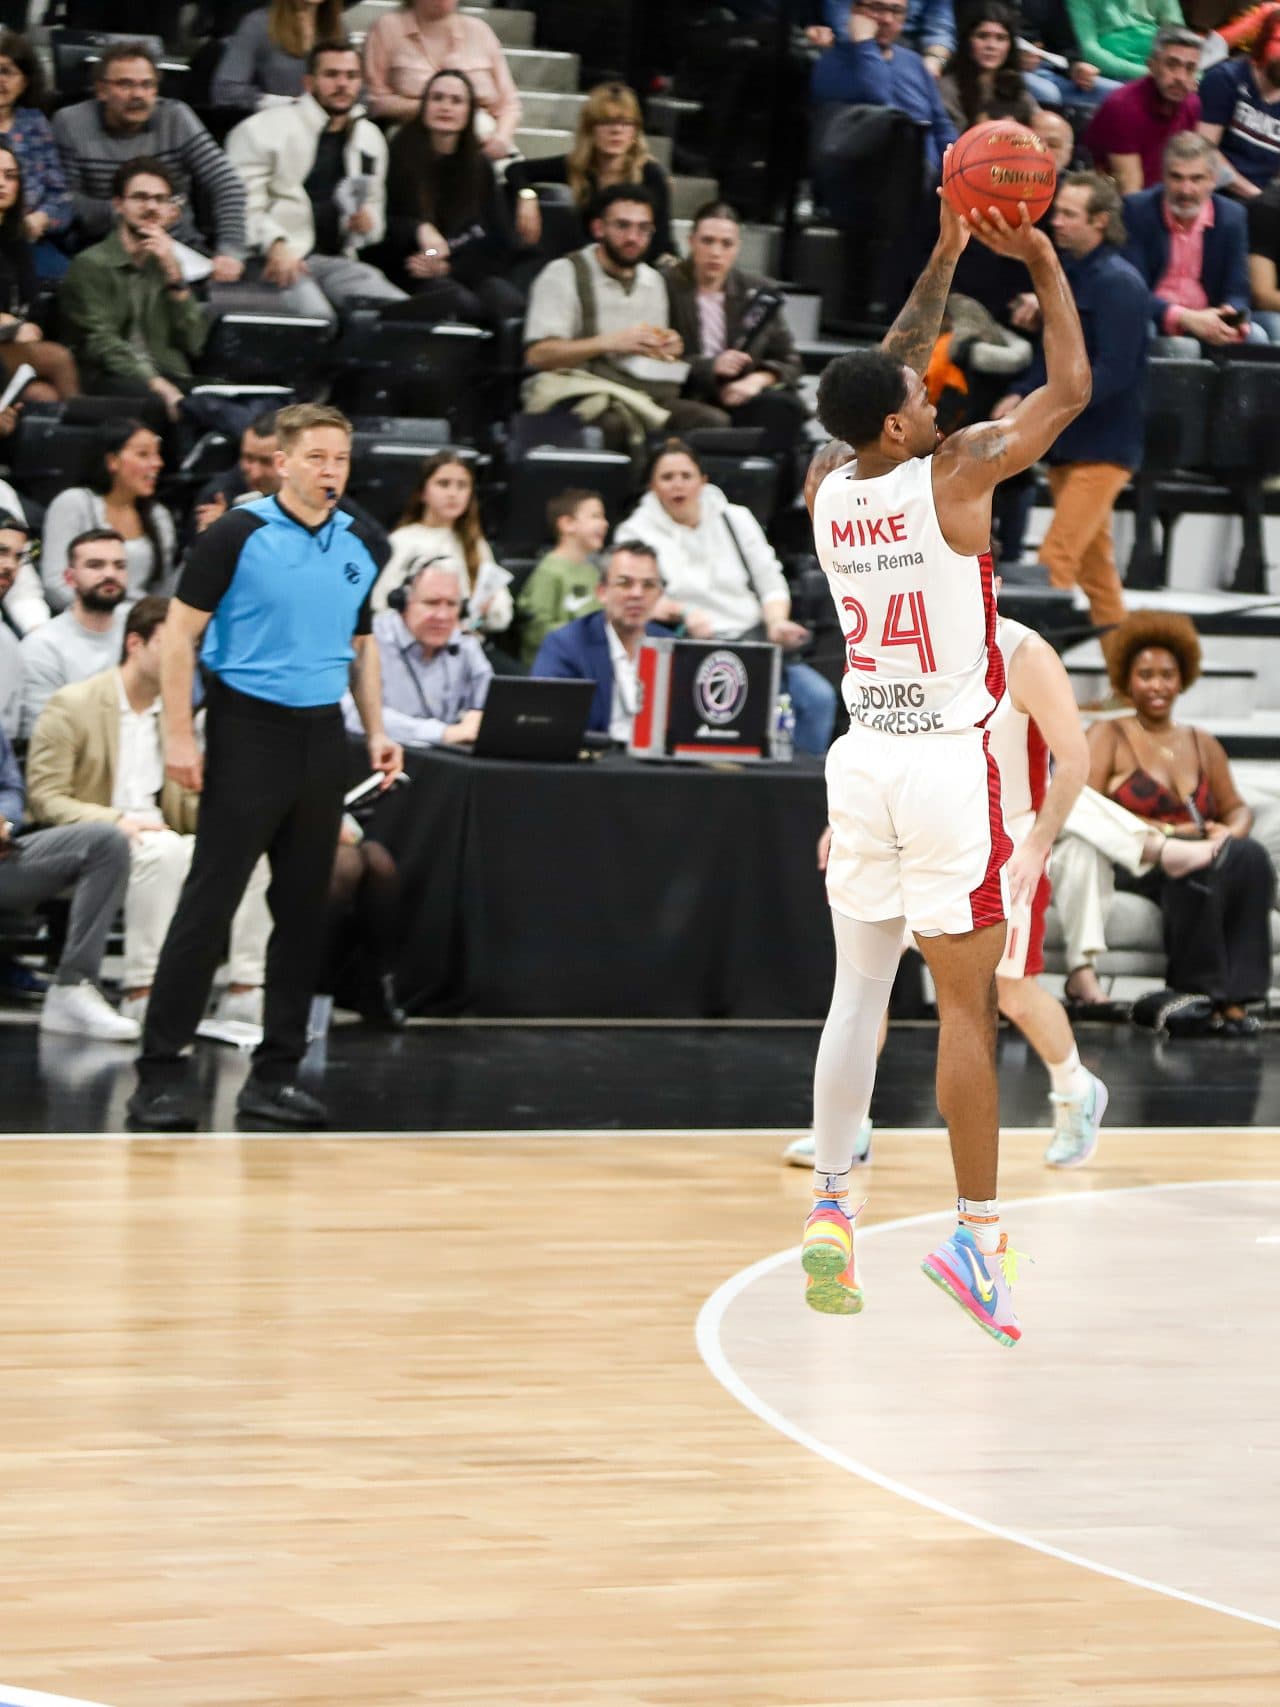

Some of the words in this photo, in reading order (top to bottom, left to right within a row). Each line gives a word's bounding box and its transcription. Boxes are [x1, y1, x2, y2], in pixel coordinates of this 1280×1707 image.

[831, 513, 907, 548] MIKE
[832, 560, 872, 575] Charles
[842, 590, 937, 673] 24
[860, 683, 925, 710] BOURG
[871, 711, 944, 735] BRESSE
